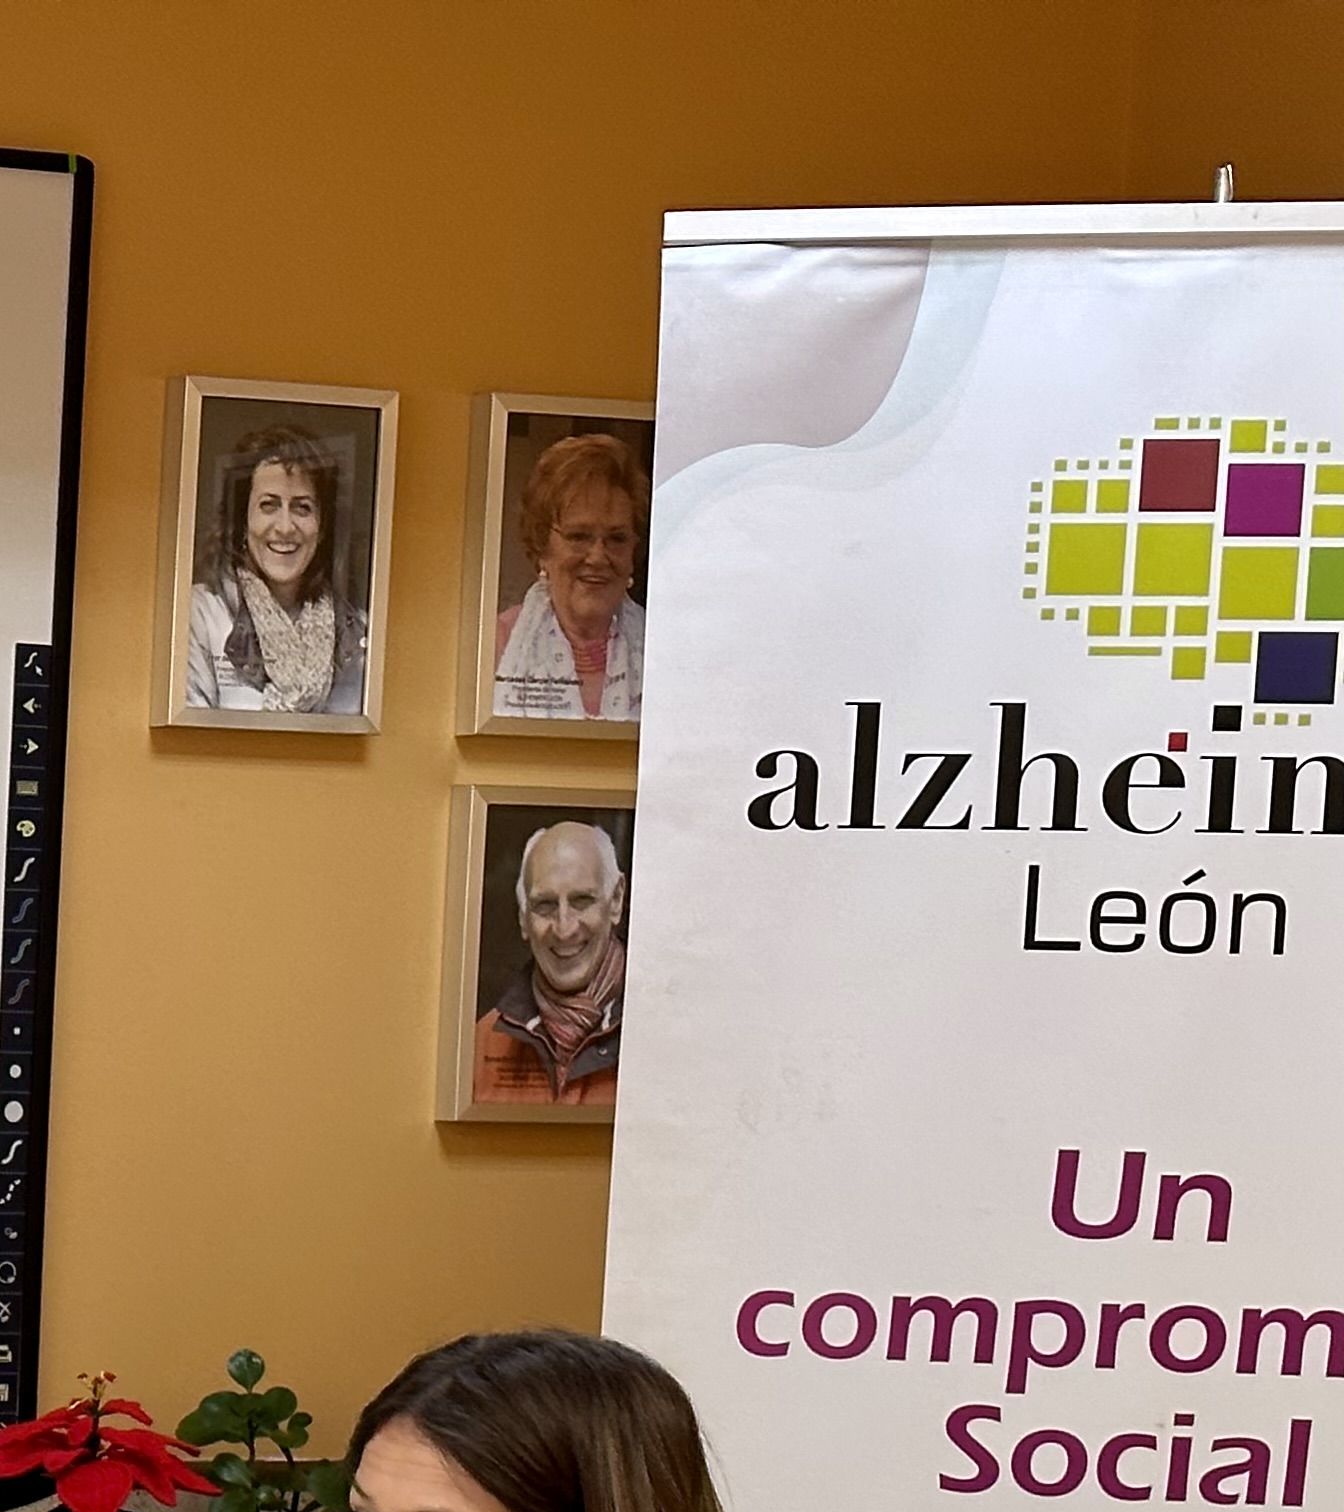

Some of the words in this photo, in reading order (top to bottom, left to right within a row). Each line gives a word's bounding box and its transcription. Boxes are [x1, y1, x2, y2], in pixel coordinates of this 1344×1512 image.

[1023, 864, 1288, 955] León
[1051, 1148, 1233, 1242] Un
[938, 1403, 1313, 1508] Social
